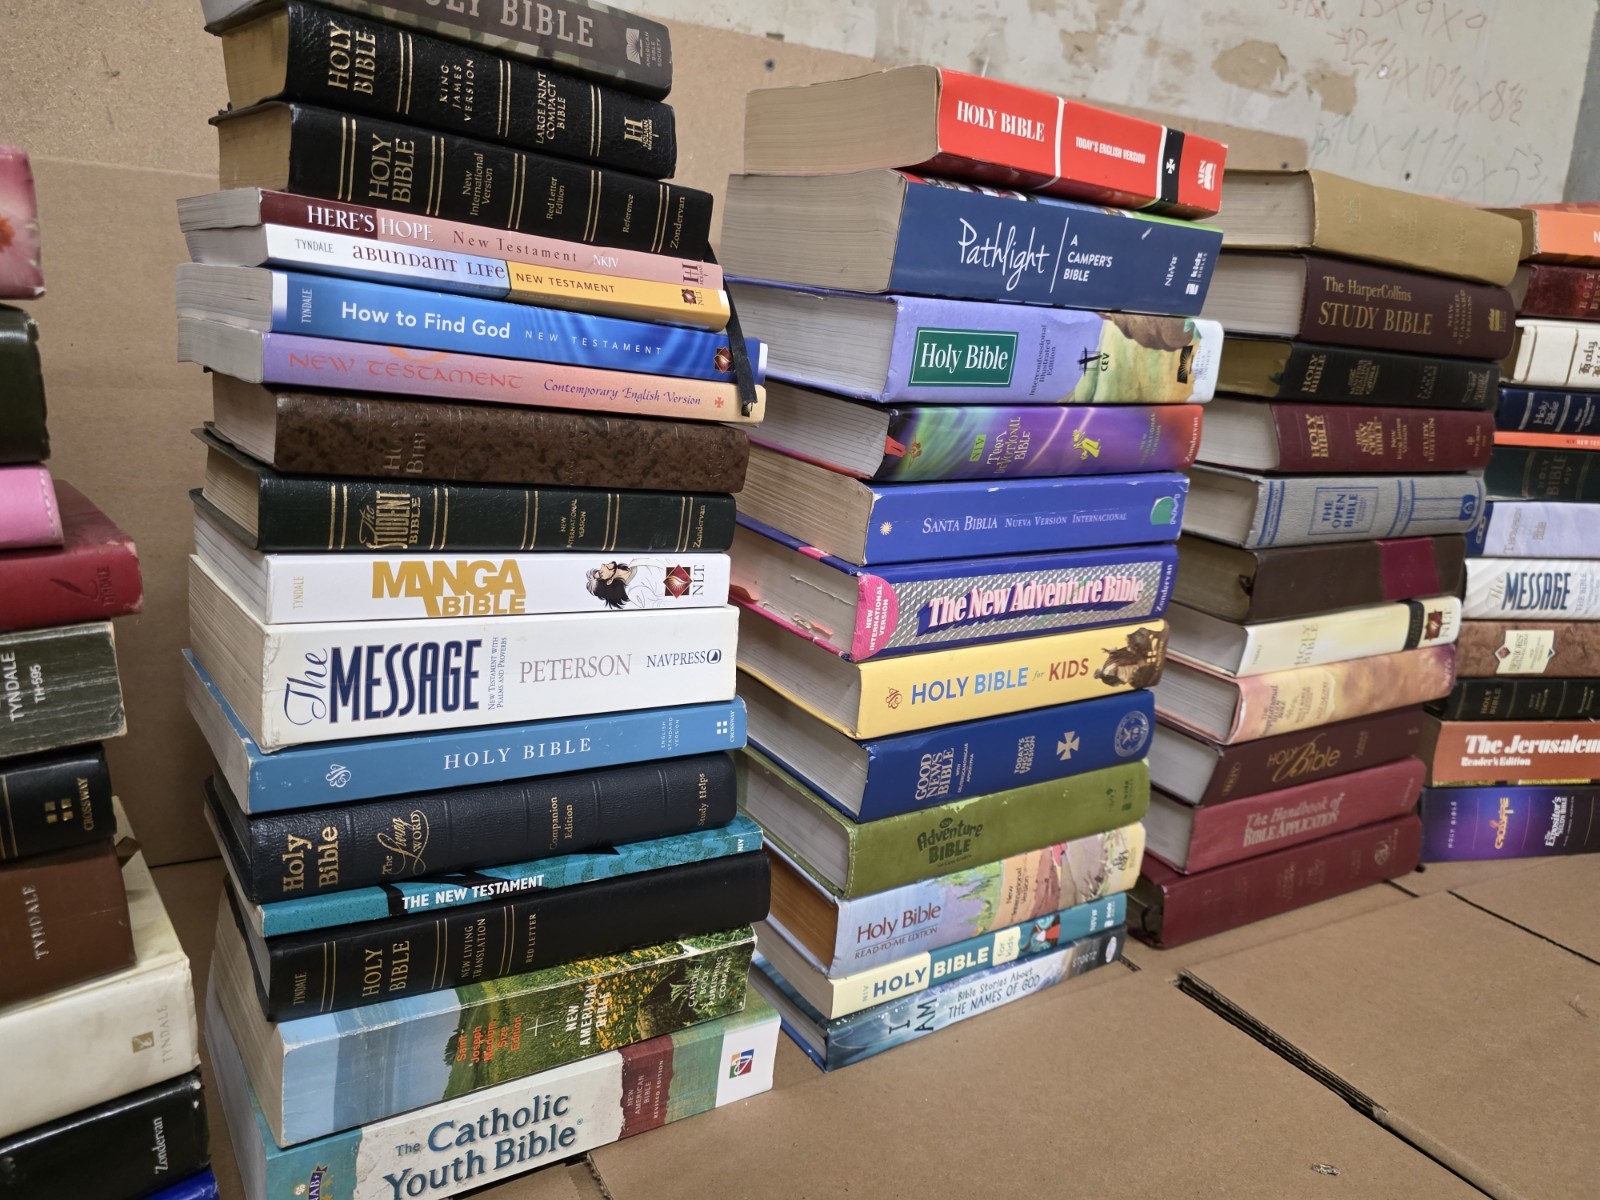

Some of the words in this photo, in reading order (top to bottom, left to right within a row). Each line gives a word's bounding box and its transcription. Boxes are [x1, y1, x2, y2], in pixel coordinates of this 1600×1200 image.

[500, 0, 594, 48] BIBLE
[327, 20, 352, 91] HOLY
[352, 30, 376, 95] BIBLE
[439, 64, 450, 103] KING
[452, 64, 462, 110] JAMES
[463, 58, 475, 122] VERSION
[537, 71, 547, 108] PRINT
[535, 108, 545, 145] LARGE
[545, 81, 557, 140] COMPACT
[556, 96, 566, 130] BIBLE
[956, 100, 997, 130] HOLY
[1000, 112, 1045, 142] BIBLE
[368, 133, 392, 200] HOLY
[391, 138, 415, 204] BIBLE
[462, 170, 473, 196] New
[469, 152, 484, 217] International
[481, 167, 493, 205] Version
[555, 184, 565, 215] Edition
[622, 193, 634, 234] Reference
[306, 205, 375, 233] HERE'S
[380, 217, 435, 242] HOPE
[453, 230, 489, 249] New
[496, 237, 577, 263] Testament
[670, 196, 686, 250] Zondervan
[1070, 234, 1078, 247] A
[294, 238, 335, 254] TYNDALE
[957, 217, 1050, 292] Pathlight
[1066, 251, 1113, 269] CAMPER'S
[515, 272, 544, 284] NEW
[549, 276, 615, 295] TESTAMENT
[1063, 267, 1090, 282] BIBLE
[1323, 275, 1345, 294] The
[1348, 279, 1412, 302] HarperCollins
[301, 288, 313, 323] TYNDALE
[1318, 301, 1380, 330] STUDY
[1383, 308, 1434, 336] BIBLE
[341, 301, 389, 324] How
[396, 310, 417, 328] to
[424, 312, 465, 334] Find
[472, 318, 510, 339] God
[525, 330, 559, 343] NEW
[571, 336, 662, 355] TESTAMENT
[920, 341, 963, 374] Holy
[964, 343, 1009, 371] Bible
[1029, 324, 1047, 396] Interconfessional
[1100, 352, 1110, 372] CEV
[1301, 354, 1317, 392] HOLY
[1309, 354, 1327, 394] BIBLE
[289, 351, 355, 373] NEW
[366, 359, 524, 390] TESTAMENT
[543, 379, 619, 400] Contemporary
[622, 387, 660, 403] English
[663, 391, 701, 406] Version
[1532, 400, 1550, 424] Holy
[1544, 401, 1559, 425] Bible
[1305, 413, 1321, 458] HOLY
[1316, 414, 1329, 458] BIBLE
[1358, 422, 1368, 453] NEW
[1366, 420, 1377, 456] OPEN
[1374, 422, 1384, 455] BIBLE
[1422, 422, 1430, 457] STUDY
[1428, 417, 1436, 462] EDITION
[1538, 459, 1549, 489] HOLY
[1546, 453, 1567, 497] BIBLE
[365, 490, 412, 550] STUDENT
[408, 496, 421, 545] BIBLE
[560, 516, 568, 533] NEW
[578, 510, 587, 539] VERSION
[692, 504, 706, 549] Zondervan
[922, 516, 961, 534] SANTA
[963, 515, 998, 532] BIBLIA
[1004, 517, 1032, 528] NUEVA
[1321, 500, 1334, 523] THE
[1332, 493, 1347, 529] OPEN
[1344, 493, 1358, 529] BIBLE
[371, 558, 527, 617] MANGA
[692, 563, 705, 597] NLT
[1501, 572, 1572, 611] MESSAGE
[440, 593, 527, 618] BIBLE
[865, 609, 874, 631] NEW
[869, 583, 883, 652] INTERNATIONAL
[878, 598, 890, 638] VERSION
[928, 594, 967, 628] The
[966, 587, 1012, 620] New
[1101, 574, 1144, 603] Bible
[646, 650, 706, 668] NAVPRESS
[1294, 624, 1313, 667] HOLY
[1301, 624, 1320, 665] BIBLE
[284, 647, 329, 726] The
[328, 639, 483, 725] MESSAGE
[519, 653, 632, 684] PETERSON
[911, 676, 969, 705] HOLY
[973, 666, 1029, 695] BIBLE
[1031, 670, 1045, 682] for
[1048, 657, 1090, 682] KIDS
[1480, 689, 1493, 714] HOLY
[1490, 688, 1502, 715] BIBLE
[443, 747, 511, 770] HOLY
[522, 737, 592, 760] BIBLE
[1267, 747, 1300, 768] HOLY
[1460, 756, 1499, 767] Reader's
[1500, 756, 1531, 767] Edition
[1465, 734, 1504, 755] The
[699, 773, 709, 799] Helps
[915, 753, 934, 801] GOOD
[926, 751, 944, 799] NEWS
[937, 747, 955, 796] BIBLE
[76, 777, 95, 831] CROSSWAY
[549, 796, 559, 850] Companion
[564, 804, 573, 840] Edition
[1246, 813, 1269, 836] The
[1270, 797, 1328, 824] Handbook
[1545, 796, 1563, 847] Expositor's
[917, 819, 983, 853] Adventure
[1243, 820, 1276, 848] BIBLE
[1277, 810, 1338, 837] APPLICATION
[282, 833, 312, 892] Holy
[318, 825, 339, 888] Bible
[382, 854, 394, 875] The
[929, 838, 971, 865] BIBLE
[401, 894, 429, 910] THE
[435, 888, 468, 905] NEW
[471, 874, 545, 899] TESTAMENT
[463, 924, 474, 959] LIVING
[527, 913, 537, 946] LETTER
[857, 916, 896, 945] Holy
[900, 901, 942, 929] Bible
[905, 926, 938, 946] EDITION
[388, 939, 410, 993] BIBLE
[473, 917, 486, 979] TRANSLATION
[362, 948, 383, 998] HOLY
[460, 959, 468, 979] NEW
[872, 966, 927, 998] HOLY
[933, 946, 989, 980] BIBLE
[579, 982, 598, 1046] AMERICAN
[595, 990, 611, 1029] BIBLE
[914, 997, 938, 1033] AM
[948, 1004, 966, 1019] THE
[970, 990, 1002, 1011] NAMES
[1005, 982, 1018, 996] OF
[1021, 974, 1041, 992] GOD
[156, 1004, 173, 1064] TYNDALE
[565, 1004, 580, 1033] NEW
[395, 1141, 421, 1157] The
[427, 1093, 570, 1153] Catholic
[151, 1115, 169, 1175] Zondervan
[383, 1148, 486, 1200] Youth
